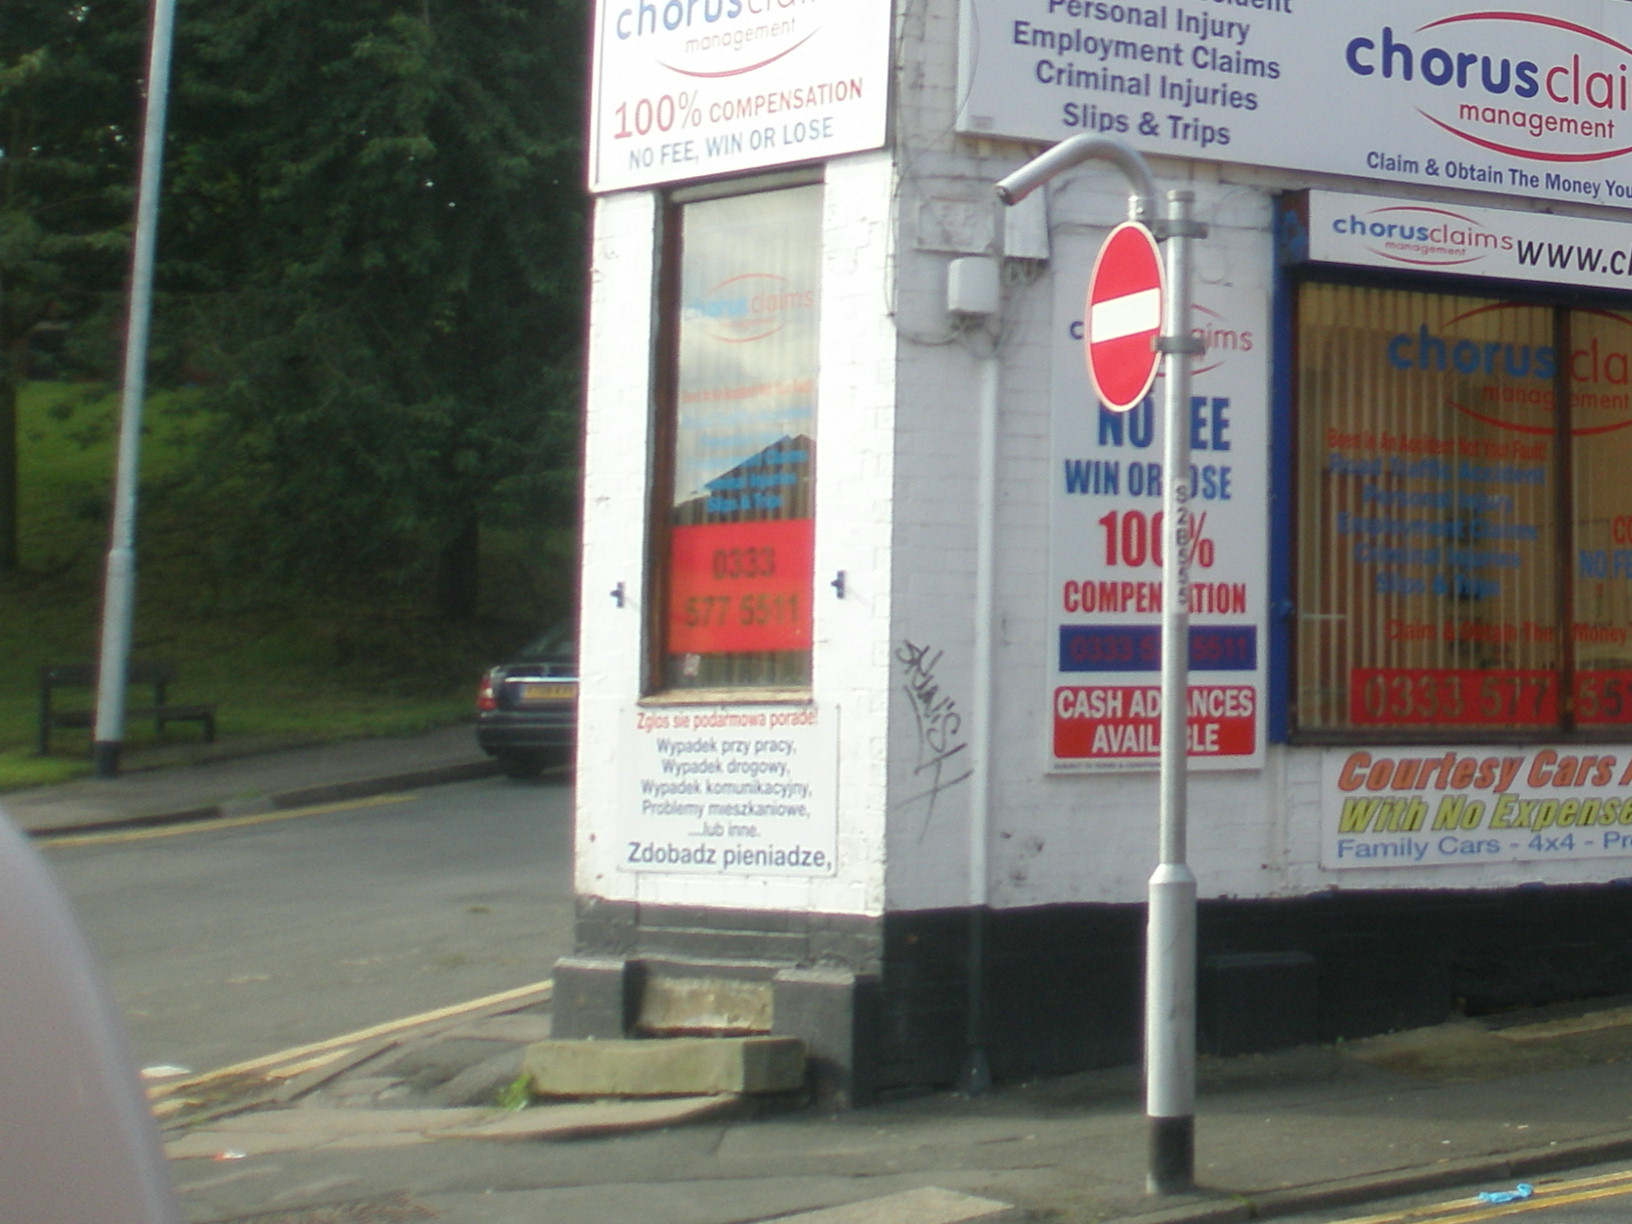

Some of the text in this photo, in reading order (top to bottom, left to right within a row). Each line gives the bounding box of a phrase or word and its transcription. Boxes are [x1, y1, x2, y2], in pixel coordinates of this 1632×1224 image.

[684, 17, 796, 54] management
[1176, 8, 1250, 47] Injury
[1012, 20, 1281, 81] Employment Claims
[1035, 59, 1259, 112] Criminal Injuries
[613, 77, 864, 140] 100% COMPENSATION
[1062, 102, 1231, 149] Slips & Trips
[1458, 101, 1616, 142] management
[628, 147, 654, 170] NO
[705, 132, 743, 158] WIN
[749, 126, 776, 151] OR
[782, 116, 835, 145] LOSE
[1366, 150, 1419, 178] Claim
[1425, 158, 1441, 178] &
[1444, 159, 1504, 187] Obtain
[1508, 167, 1541, 191] The
[1544, 171, 1601, 200] Money
[1331, 212, 1515, 252] chorusclaims
[1384, 239, 1467, 258] management
[1097, 396, 1155, 449] NO
[1064, 458, 1120, 496] WIN
[1128, 461, 1164, 498] OR
[1098, 509, 1215, 569] 100%
[712, 545, 776, 581] 0333
[1579, 549, 1608, 580] NO
[684, 592, 800, 627] 577 5511
[1063, 580, 1247, 614] COMPENTION
[1071, 635, 1134, 663] 0333
[1572, 623, 1627, 646] Money
[1056, 688, 1254, 719] CASH ADNCES
[1364, 675, 1465, 718] 0333
[1479, 677, 1551, 718] 577
[656, 738, 718, 756] Wypadek
[720, 739, 751, 756] przy
[1091, 723, 1220, 755] AVAILLE
[661, 758, 723, 777] Wypadek
[1337, 750, 1524, 793] Courtesy
[1526, 748, 1620, 789] Cars
[640, 779, 702, 798] Wypadek
[641, 800, 705, 818] Problemy
[1337, 796, 1430, 835] With
[1430, 794, 1486, 833] No
[626, 842, 833, 872] Zdobadz pieniadze,
[1337, 837, 1429, 862] Family
[1437, 834, 1501, 858] Cars
[1527, 833, 1576, 853] 4x4
